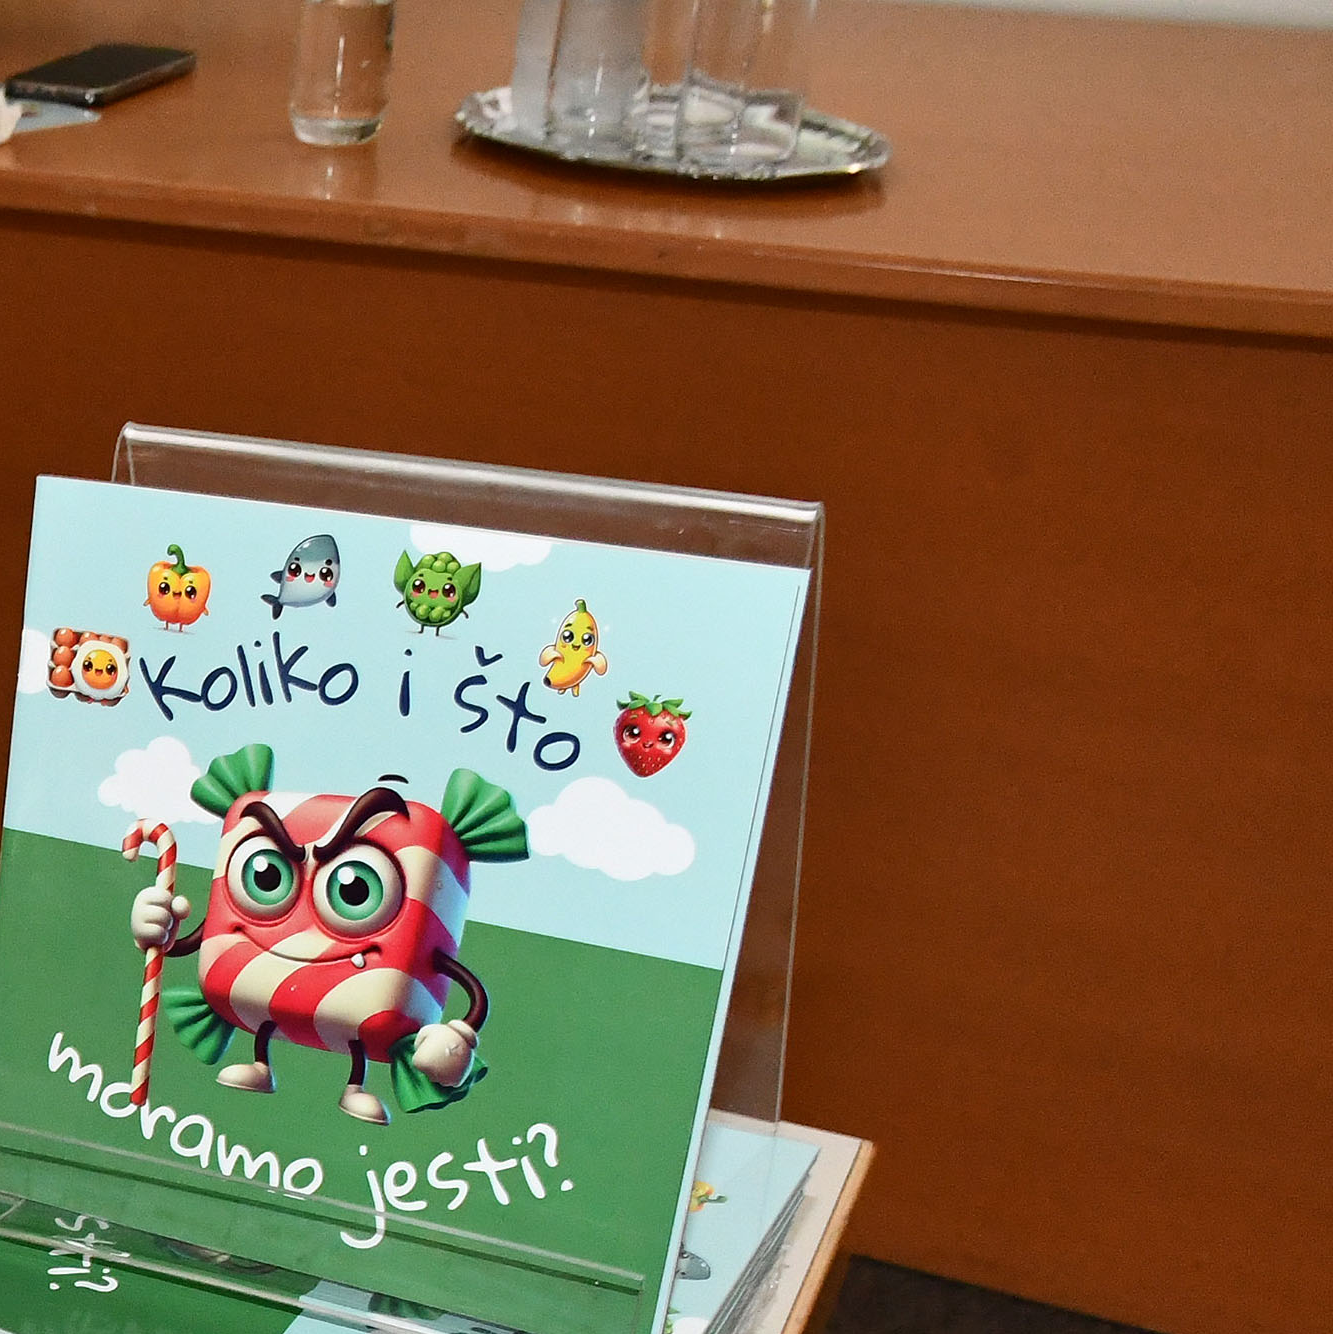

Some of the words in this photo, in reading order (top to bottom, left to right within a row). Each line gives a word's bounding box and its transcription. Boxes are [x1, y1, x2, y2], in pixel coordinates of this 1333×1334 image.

[137, 631, 360, 721] Koliko
[397, 648, 413, 716] i
[459, 643, 582, 772] Što
[46, 1031, 323, 1199] moramo
[339, 1122, 577, 1248] jesti?
